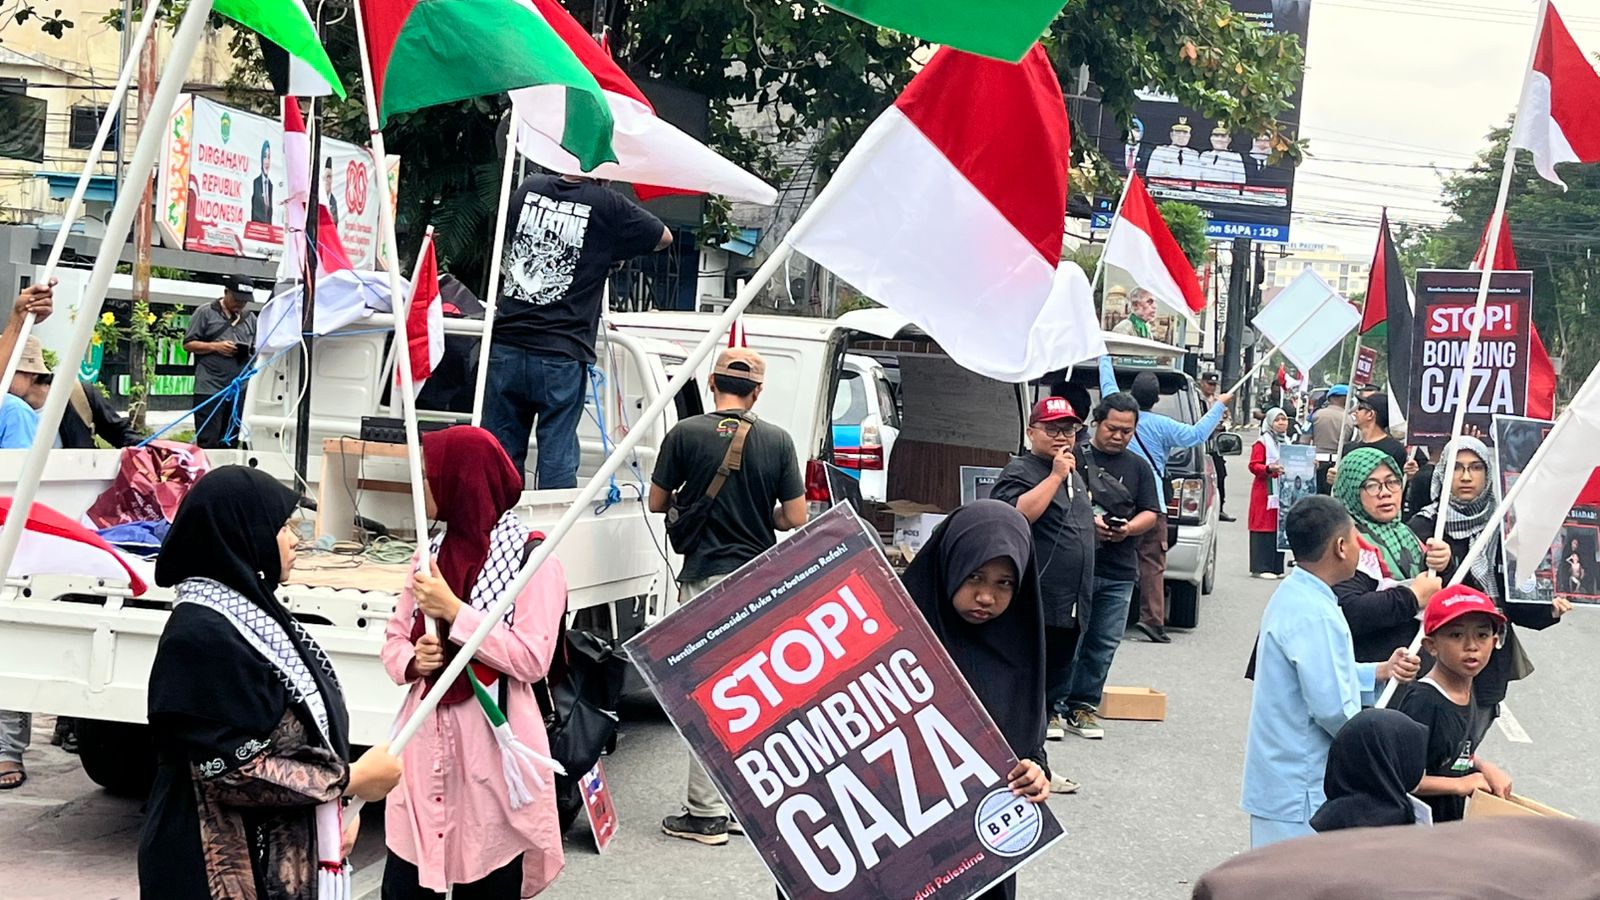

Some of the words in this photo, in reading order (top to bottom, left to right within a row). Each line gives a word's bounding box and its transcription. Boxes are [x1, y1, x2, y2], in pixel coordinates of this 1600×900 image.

[198, 143, 249, 173] DIRGAHAYU
[202, 173, 241, 198] REPUBLIK
[524, 191, 592, 218] FREE
[196, 199, 243, 223] INDONESIA
[516, 203, 589, 249] PALESTINE
[1224, 224, 1251, 236] SAPA
[1259, 228, 1279, 238] 129
[1431, 304, 1512, 333] STOP!
[1423, 340, 1516, 368] BOMBING
[1420, 367, 1514, 413] GAZA
[667, 637, 708, 666] Hentikan
[706, 608, 751, 640] Genosida!
[748, 594, 773, 614] Buka
[770, 563, 820, 598] Perbatasan
[818, 543, 848, 567] Rafah!
[711, 585, 879, 734] STOP!
[734, 648, 935, 808] BOMBING
[775, 704, 1001, 893] GAZA
[912, 883, 937, 900] duli
[935, 851, 985, 889] Palestina
